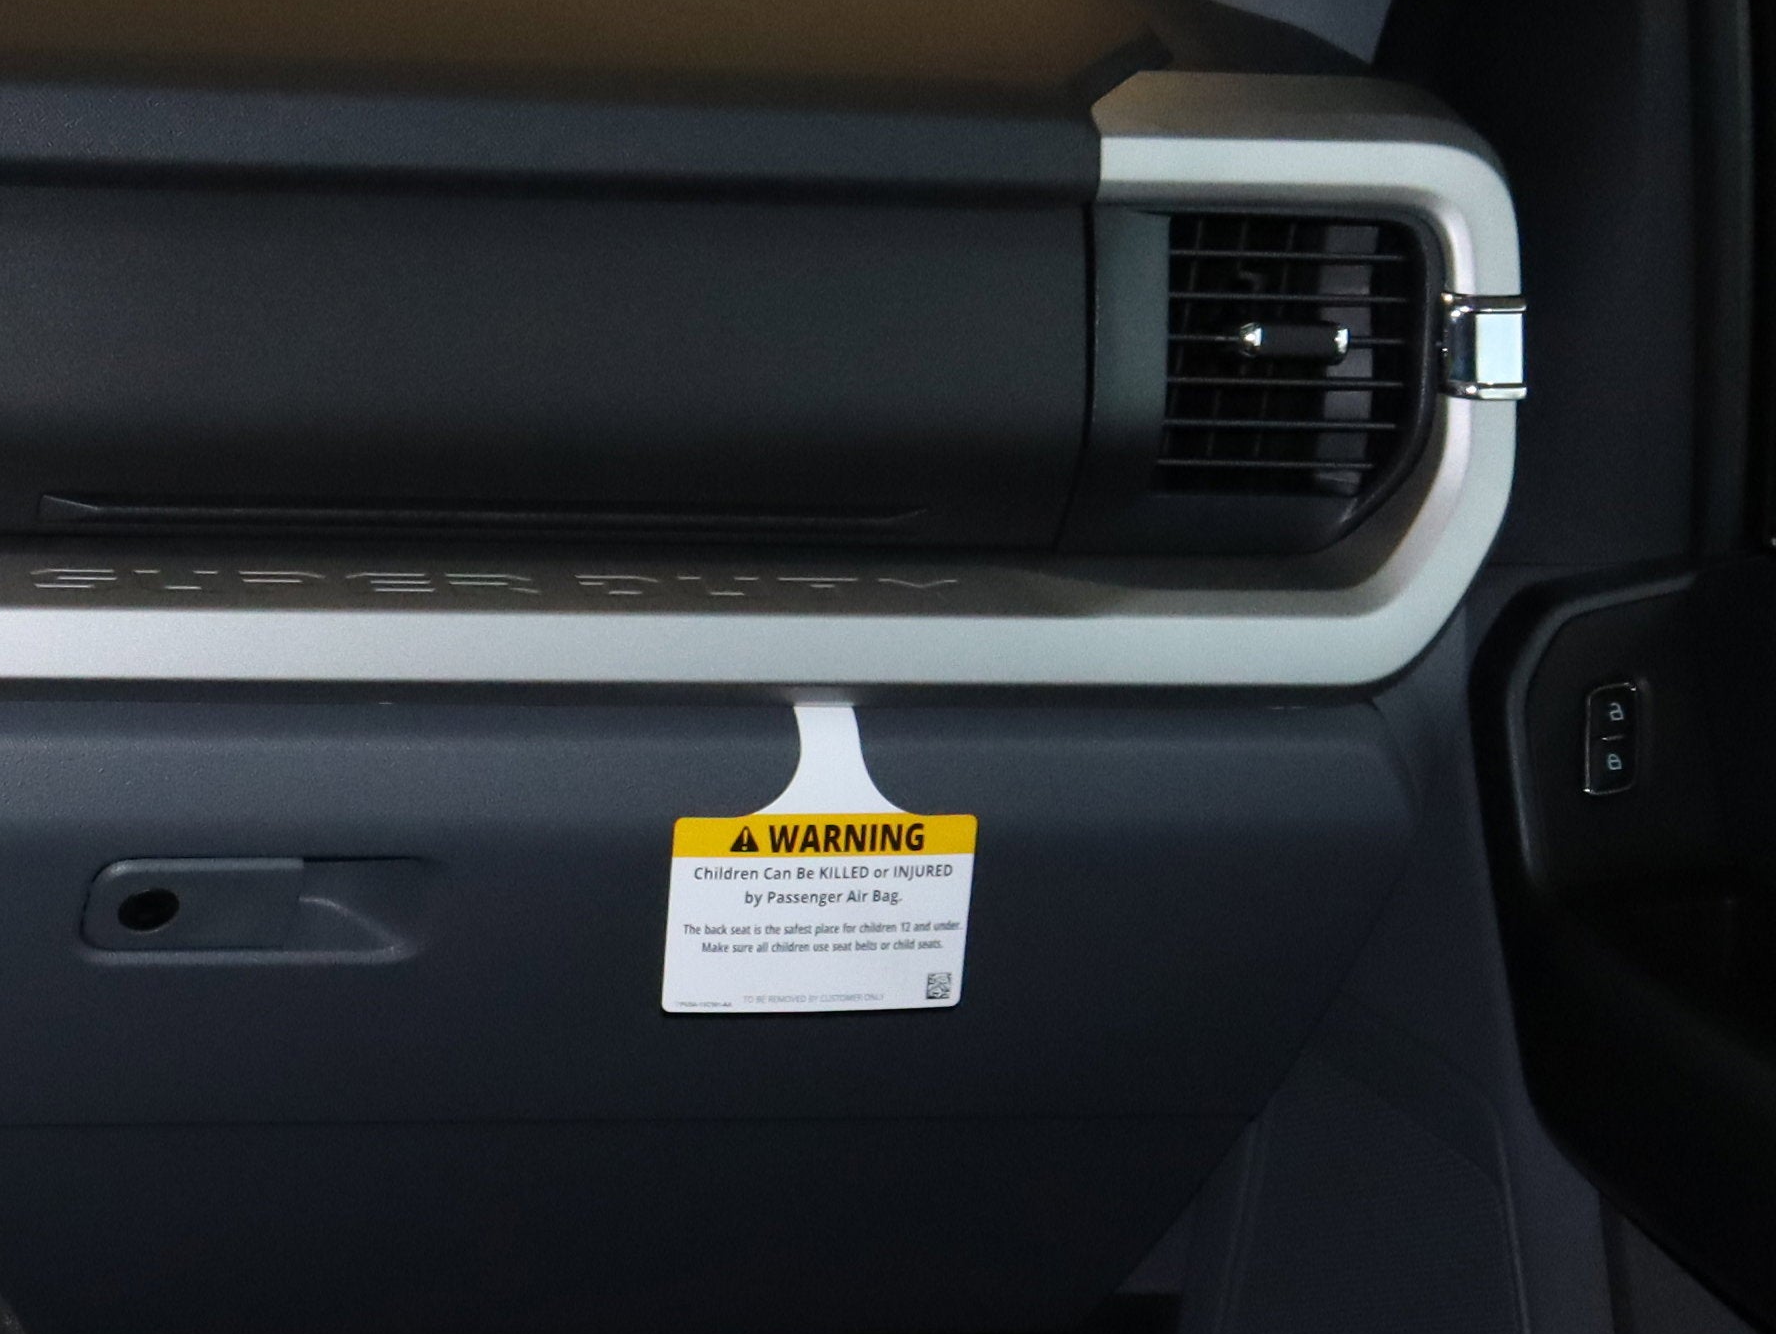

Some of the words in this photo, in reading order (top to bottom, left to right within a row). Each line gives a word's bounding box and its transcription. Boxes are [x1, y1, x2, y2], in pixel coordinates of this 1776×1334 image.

[768, 822, 925, 854] WARNING
[693, 866, 759, 881] Children
[763, 866, 792, 880] Can
[796, 866, 815, 880] Be
[819, 865, 870, 880] KILLED
[873, 868, 889, 879] or
[893, 863, 954, 882] INJURED
[744, 890, 763, 908] by
[767, 890, 843, 908] Passenger
[846, 889, 868, 903] Air
[872, 889, 903, 906] Bag.
[683, 923, 702, 936] The
[704, 923, 728, 935] back
[730, 924, 752, 935] seat
[753, 923, 762, 935] is
[764, 924, 781, 935] the
[783, 922, 812, 935] safest
[814, 922, 840, 937] place
[842, 922, 856, 934] for
[859, 921, 897, 934] children
[900, 921, 911, 933] 12
[913, 920, 931, 932] and
[701, 941, 729, 953] Make
[732, 943, 754, 953] sure
[756, 941, 769, 953] all
[771, 941, 810, 953] children
[812, 942, 830, 952] use
[832, 941, 852, 952] seat
[855, 939, 878, 952] belts
[880, 941, 891, 951] or
[893, 939, 915, 951] child
